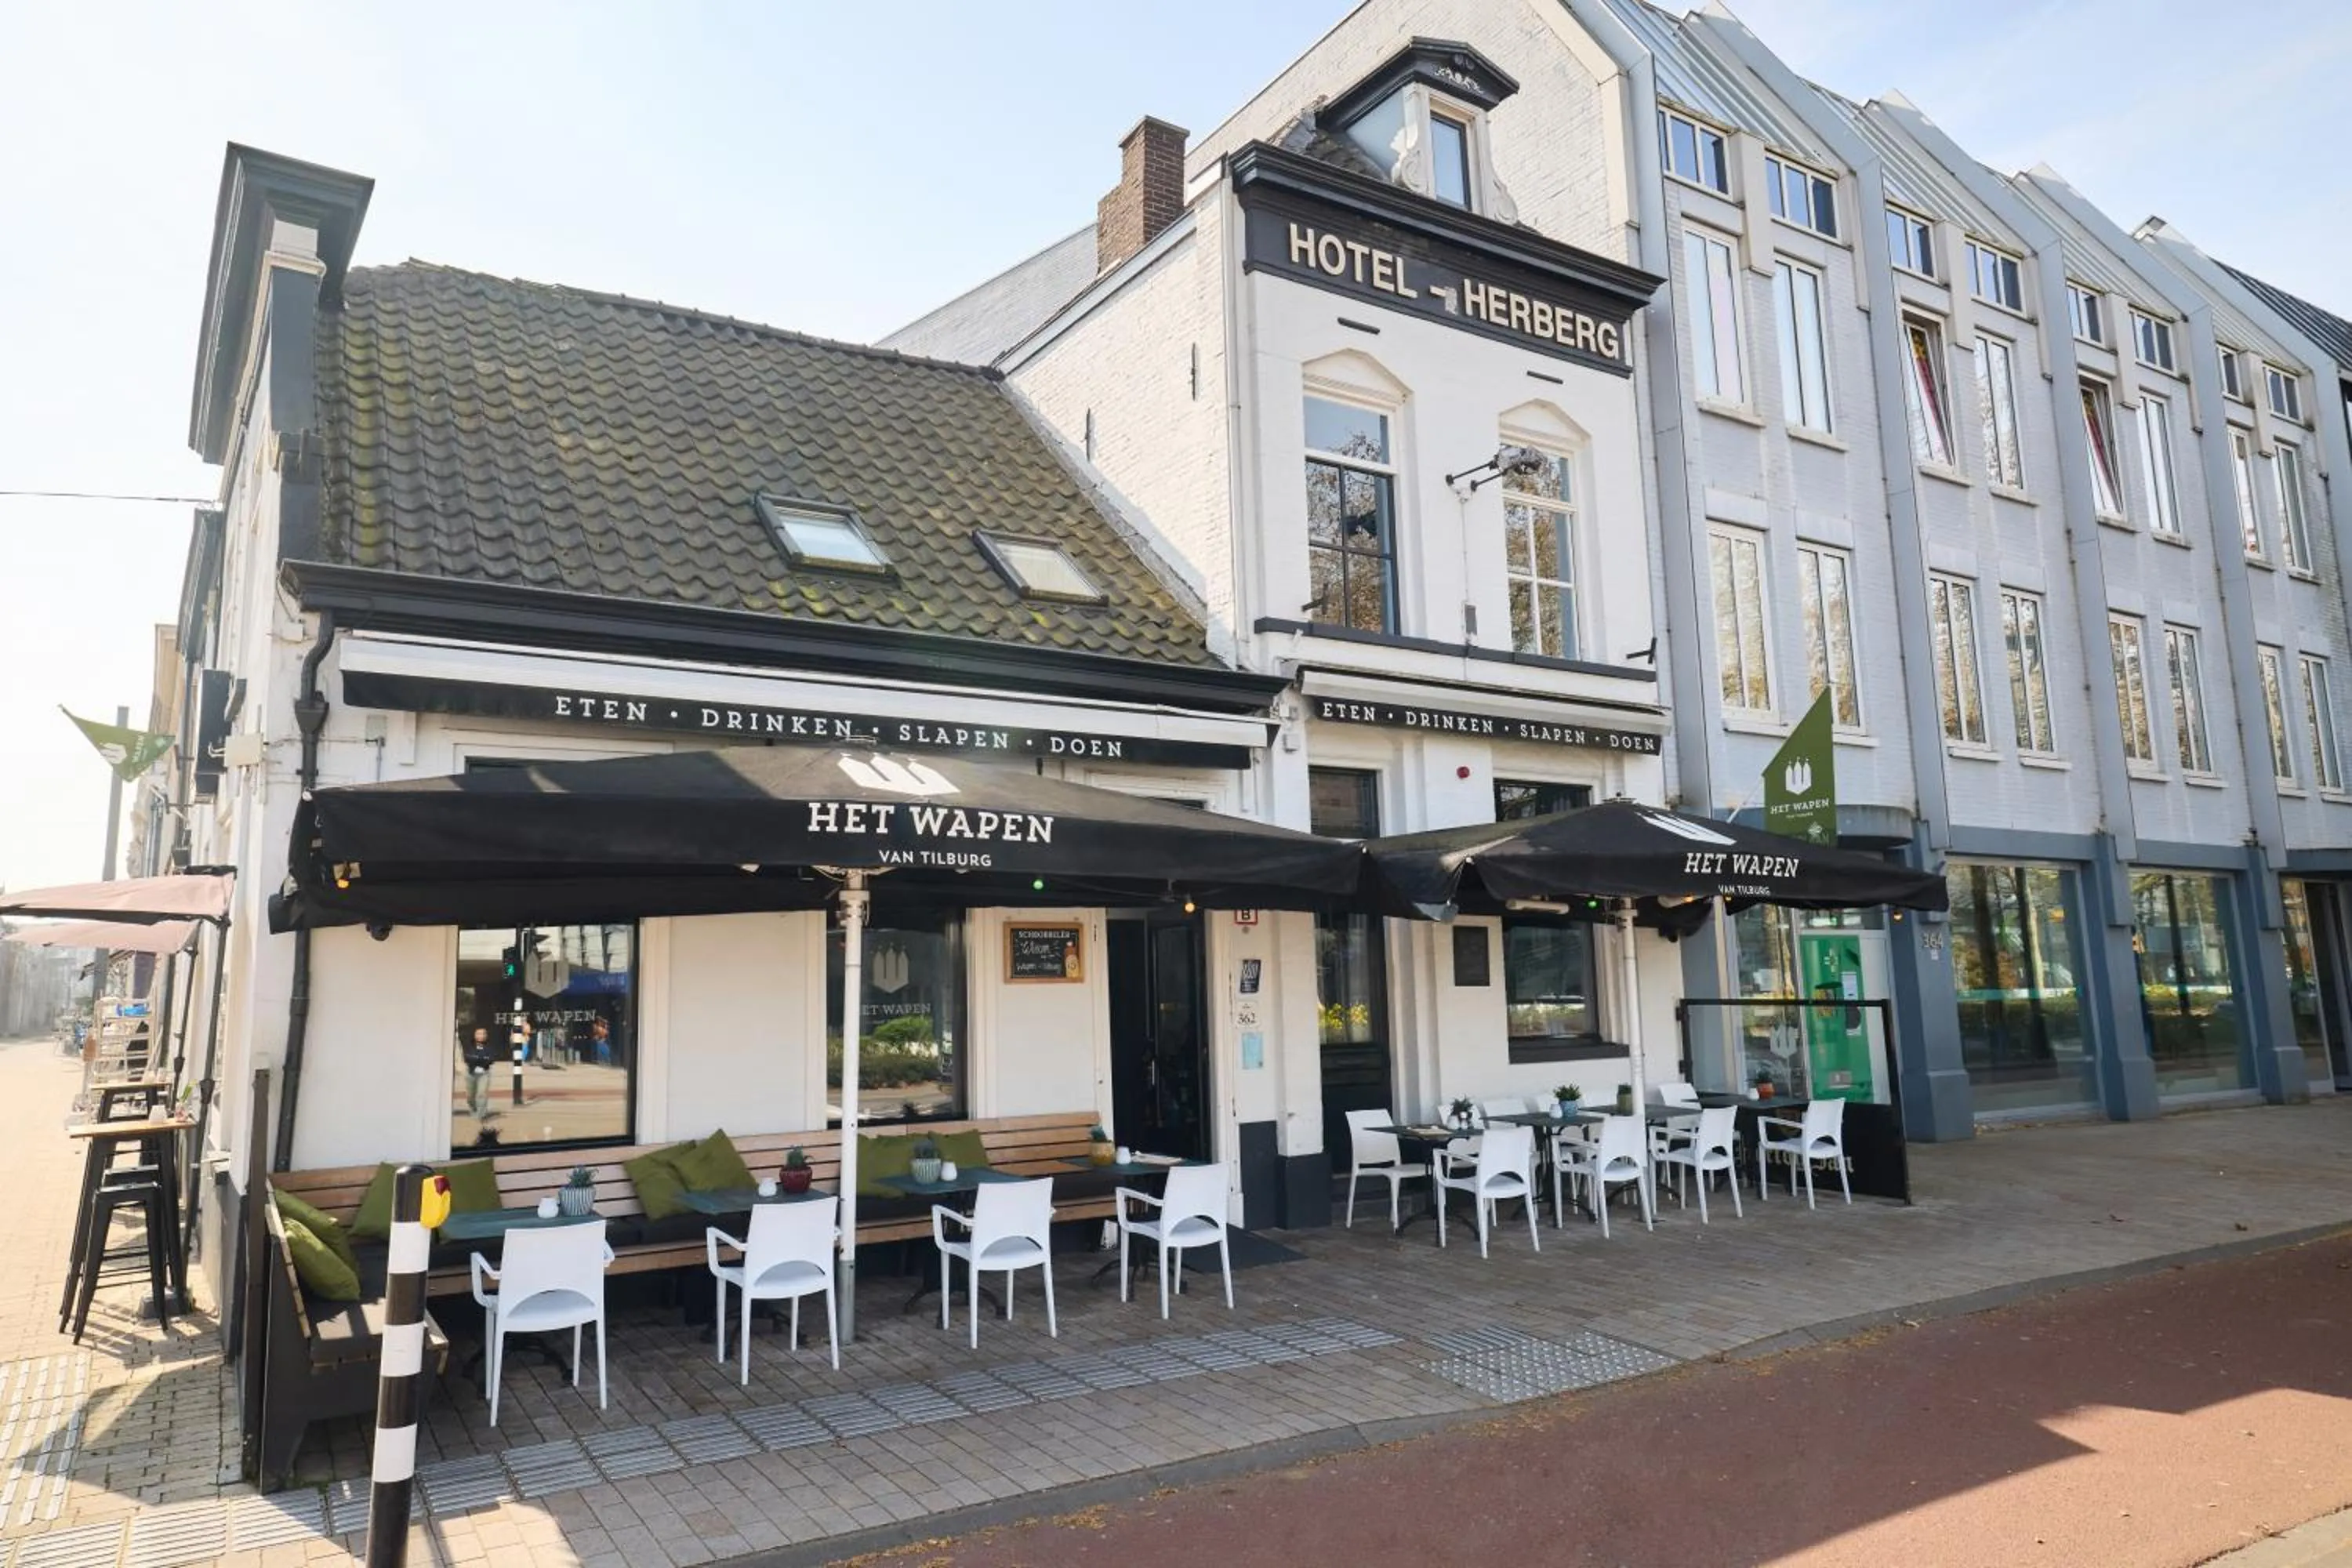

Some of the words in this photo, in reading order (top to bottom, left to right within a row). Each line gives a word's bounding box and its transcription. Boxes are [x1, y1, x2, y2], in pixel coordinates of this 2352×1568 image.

[1290, 223, 1417, 299] HOTEL
[1464, 279, 1620, 359] HERBERG
[556, 696, 647, 721] ETEN
[702, 709, 851, 736] DRINKEN
[900, 724, 1008, 750] SLAPEN
[1051, 736, 1122, 757] DOEN
[1323, 702, 1375, 720] ETEN
[1406, 711, 1493, 733] DRINKEN
[1520, 724, 1585, 744] SLAPEN
[1610, 735, 1655, 751] DOEN
[1793, 798, 1829, 811] WAPEN
[808, 803, 895, 834] HET
[909, 806, 1054, 843] WAPEN
[878, 850, 914, 864] VAN
[920, 851, 992, 866] TILBURG
[1685, 852, 1727, 873] HET
[1733, 854, 1799, 878] WAPEN
[1922, 932, 1943, 948] 364
[535, 1009, 597, 1024] WAPEN
[862, 1004, 880, 1015] ET
[883, 1003, 931, 1014] WAPEN
